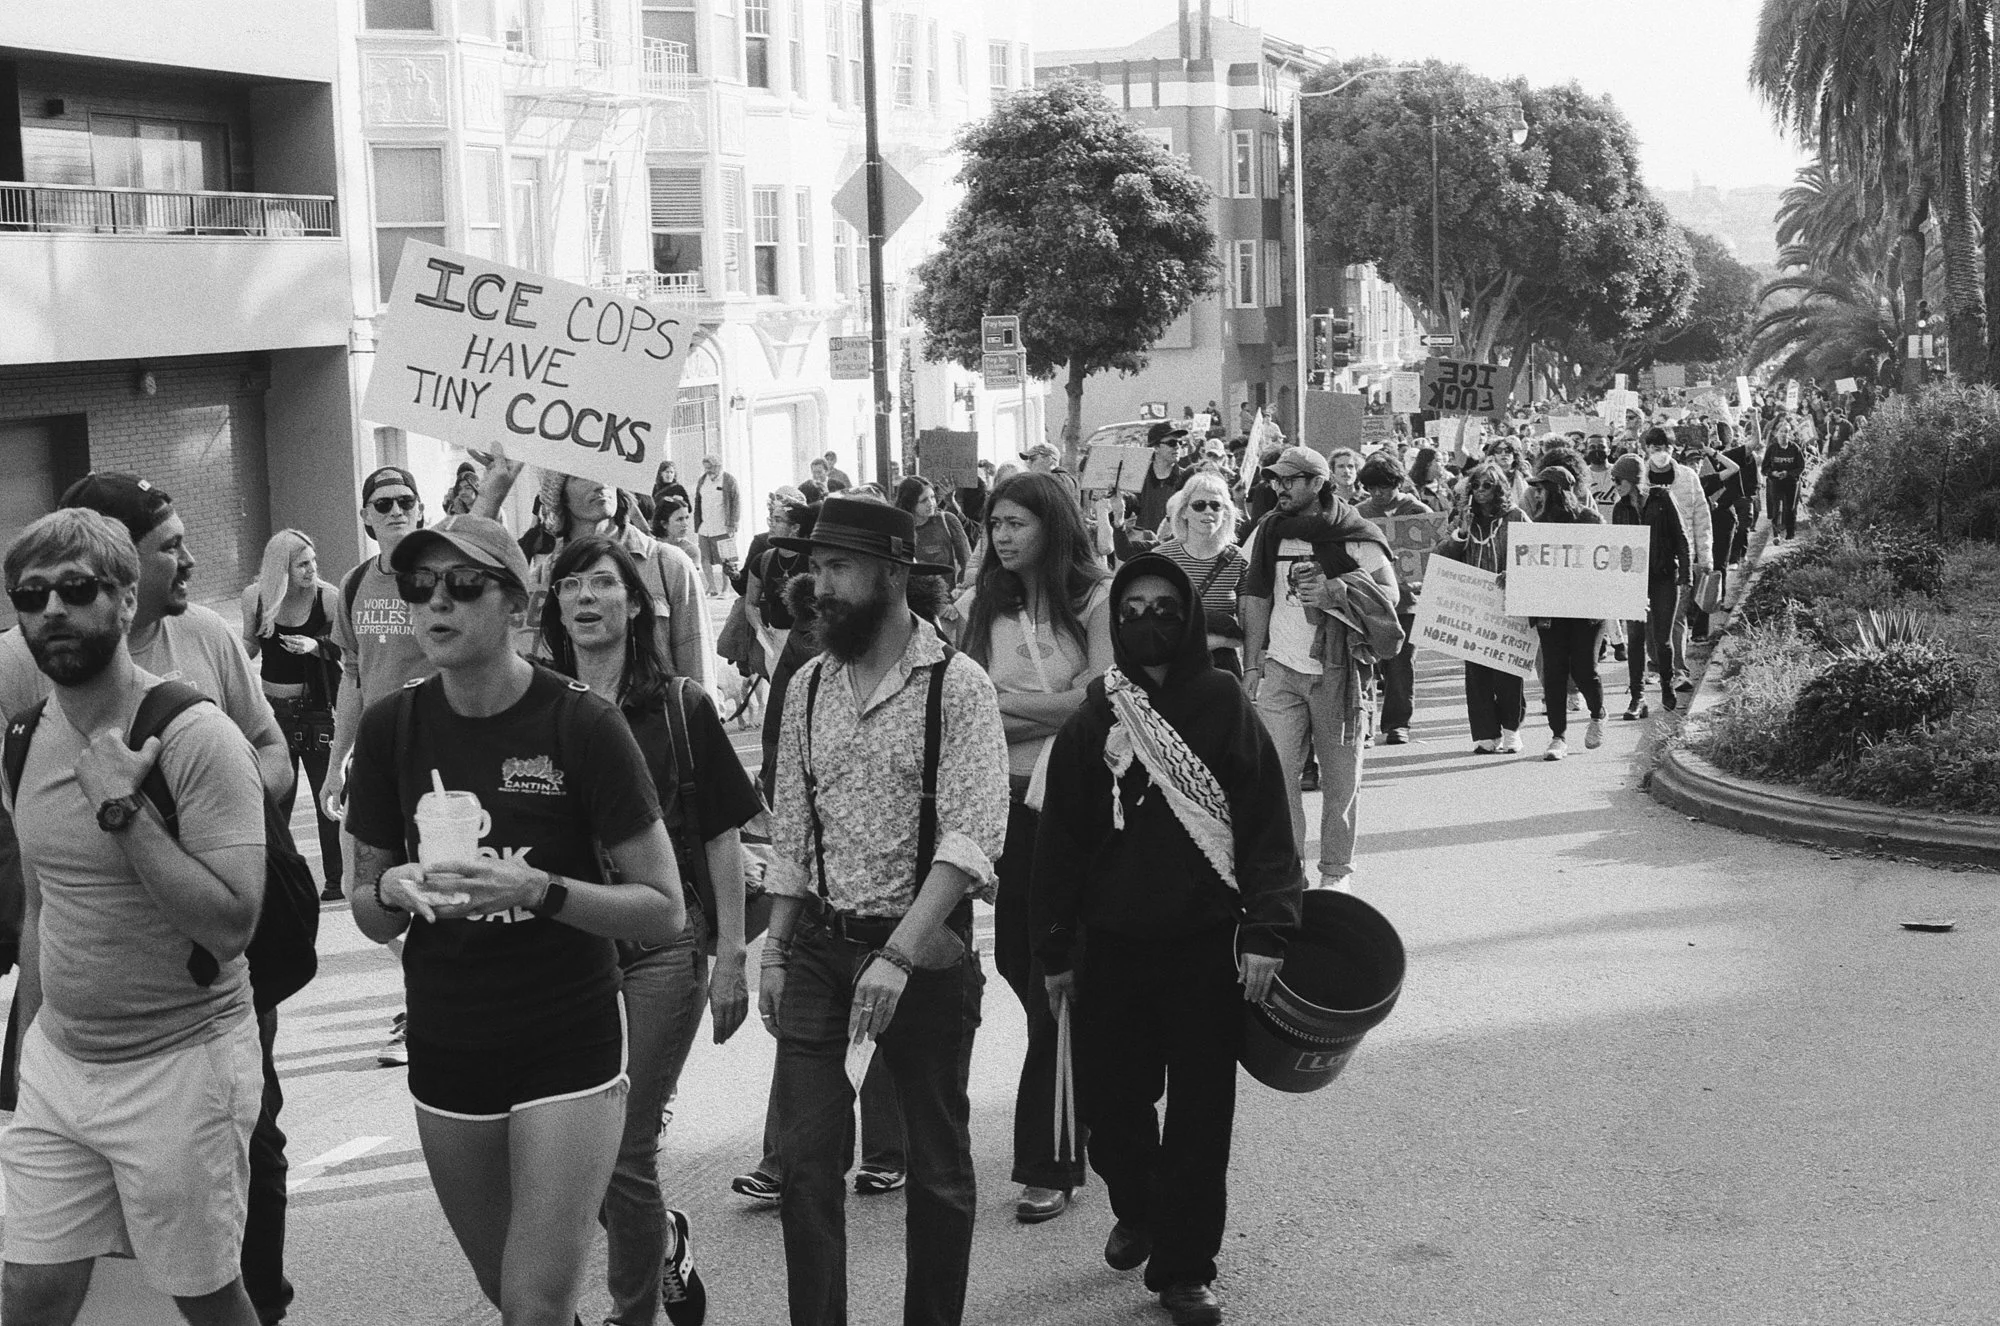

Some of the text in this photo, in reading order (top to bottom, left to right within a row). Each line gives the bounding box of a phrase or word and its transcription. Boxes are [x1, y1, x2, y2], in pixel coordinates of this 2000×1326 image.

[415, 257, 680, 360] ICE COPS
[462, 333, 576, 388] HAVE
[1438, 362, 1497, 389] ICE
[1428, 381, 1495, 411] FUCK
[407, 365, 651, 463] TINY COCKS
[1376, 517, 1444, 550] UCK
[354, 625, 416, 635] LEPRECHAUN
[356, 610, 414, 625] TALLEST
[1423, 626, 1459, 646] NOEM
[1436, 614, 1532, 653] MILLER AND KRISTI
[505, 780, 560, 792] CANTINA
